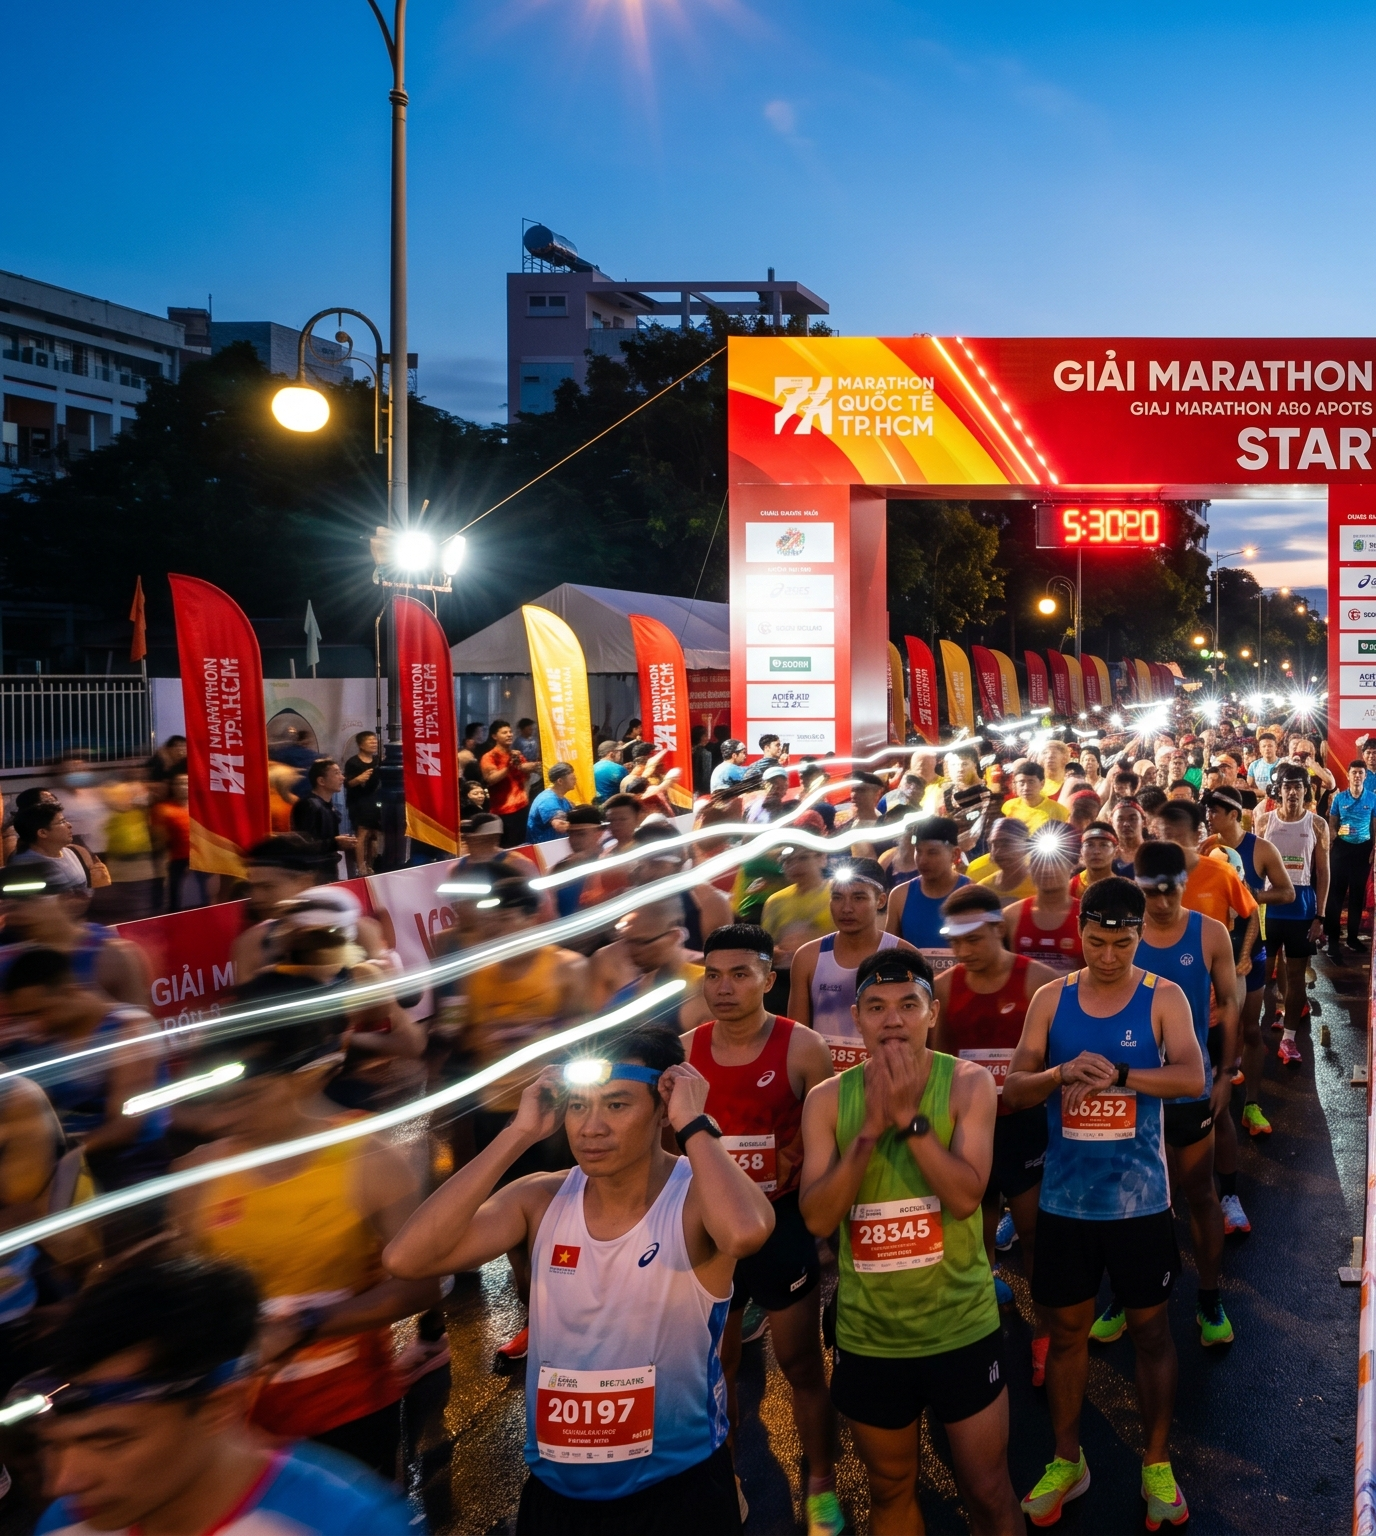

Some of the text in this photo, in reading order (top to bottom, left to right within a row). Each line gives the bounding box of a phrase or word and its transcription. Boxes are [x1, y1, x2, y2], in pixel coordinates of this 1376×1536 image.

[1053, 349, 1135, 393] GIẢI
[1149, 360, 1373, 393] MARATHON
[837, 376, 935, 391] MARATHON
[838, 391, 935, 412] QUỐC TẾ
[1130, 401, 1170, 416] GIAJ
[1176, 401, 1272, 416] MARATHON
[1315, 401, 1373, 416] APOTS
[838, 415, 934, 436] TP.HCM
[150, 963, 205, 1007] GIẢI
[859, 1218, 931, 1245] 28345
[547, 1397, 636, 1425] 20197
